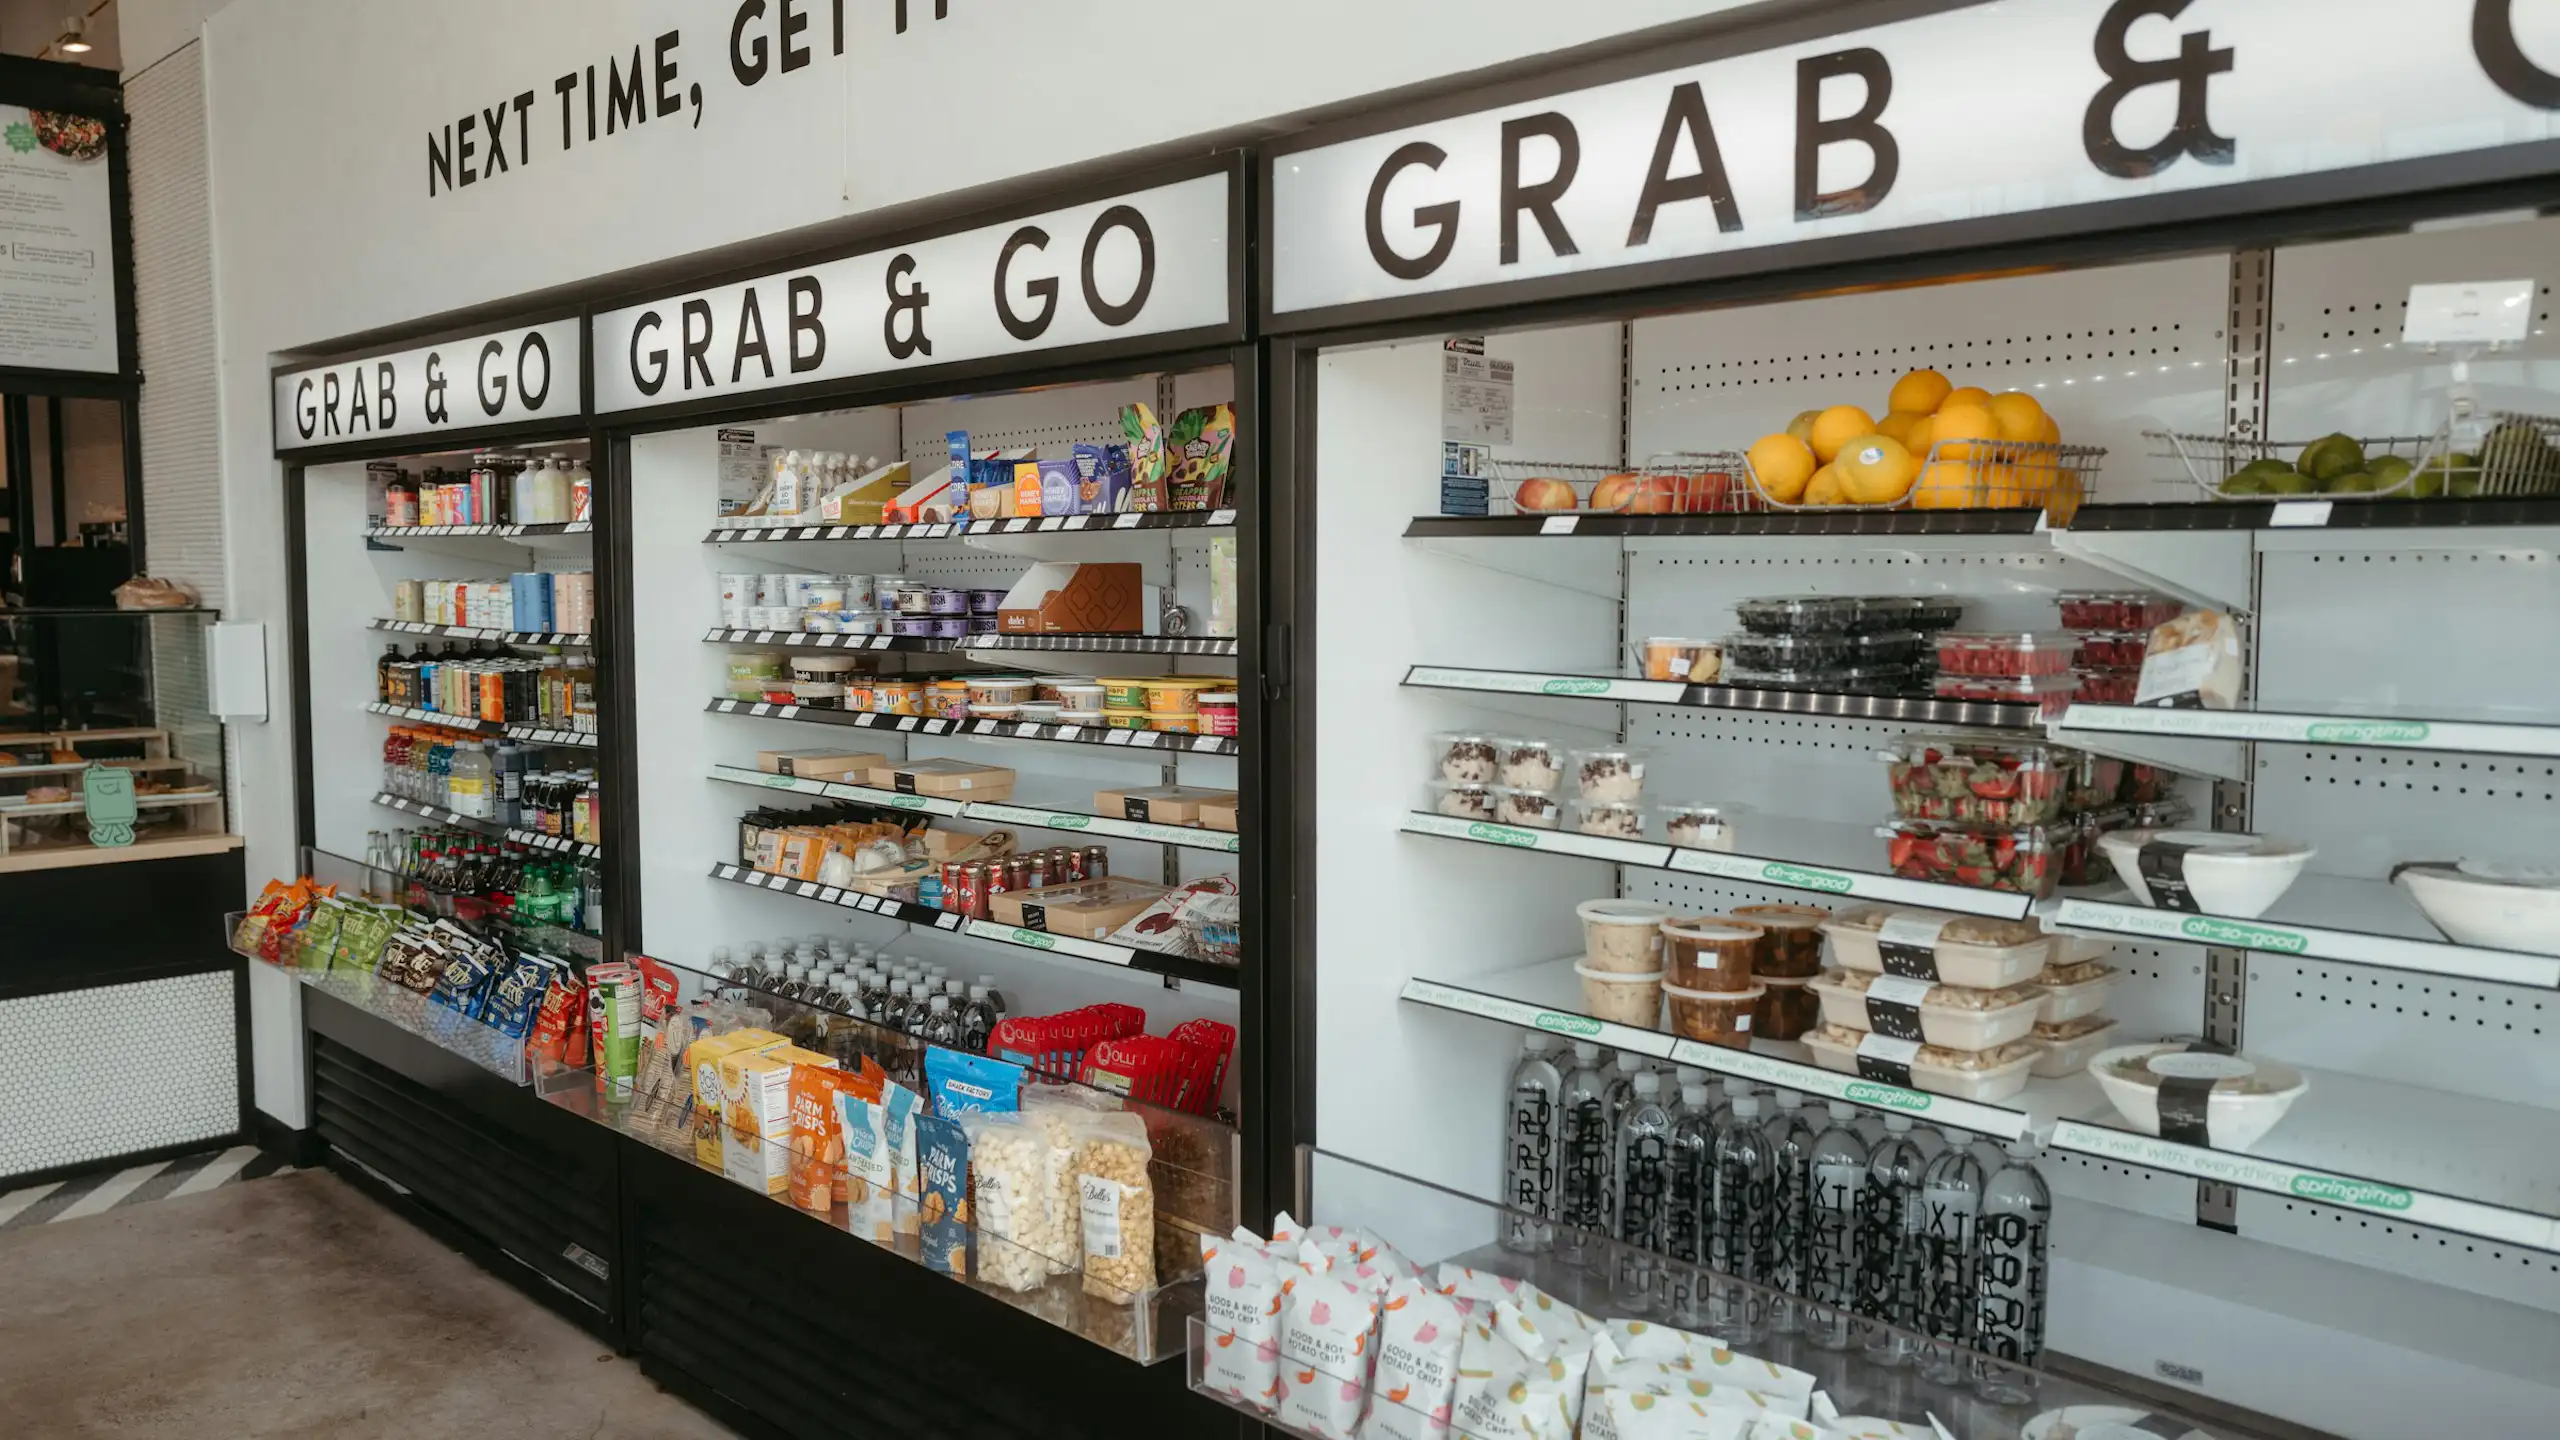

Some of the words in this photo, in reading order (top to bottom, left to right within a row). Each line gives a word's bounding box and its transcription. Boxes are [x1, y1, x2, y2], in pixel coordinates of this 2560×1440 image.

[428, 90, 535, 197] NEXT
[555, 30, 702, 149] TIME,
[730, 0, 844, 87] GET
[1365, 46, 1899, 280] GRAB
[2083, 0, 2236, 179] &
[630, 275, 826, 396] GRAB
[884, 253, 932, 360] &
[994, 205, 1155, 341] GO
[296, 361, 397, 440] GRAB
[425, 352, 448, 425] &
[478, 331, 550, 416] GO
[2311, 722, 2426, 742] springtime
[1471, 825, 1536, 846] oh-so-good
[1765, 865, 1850, 890] oh-so-good
[2069, 906, 2124, 930] Spring
[2128, 914, 2178, 932] tastes
[2187, 920, 2302, 951] oh-so-good
[1538, 1014, 1600, 1034] springtime
[1112, 1050, 1136, 1066] OLLI
[794, 1095, 823, 1118] PARM
[1848, 1086, 1929, 1110] springtime
[791, 1109, 826, 1137] CRISPS
[928, 1145, 957, 1173] PARM
[2065, 1126, 2104, 1148] Pairs
[2108, 1134, 2142, 1155] well
[2193, 1156, 2291, 1188] everything
[2295, 1175, 2407, 1209] springtime
[1208, 1304, 1235, 1320] POTATO
[1237, 1313, 1261, 1325] CHIPS
[1209, 1294, 1232, 1308] GOOD
[1242, 1303, 1259, 1315] HOT
[1288, 1337, 1317, 1357] POTATO
[1319, 1351, 1347, 1364] CHIPS
[1290, 1328, 1314, 1345] GOOD
[1325, 1342, 1344, 1354] HOT
[1382, 1353, 1414, 1375] POTATO
[1416, 1371, 1443, 1388] CHIPS
[1386, 1343, 1412, 1362] GOOD
[1425, 1361, 1444, 1375] HOT
